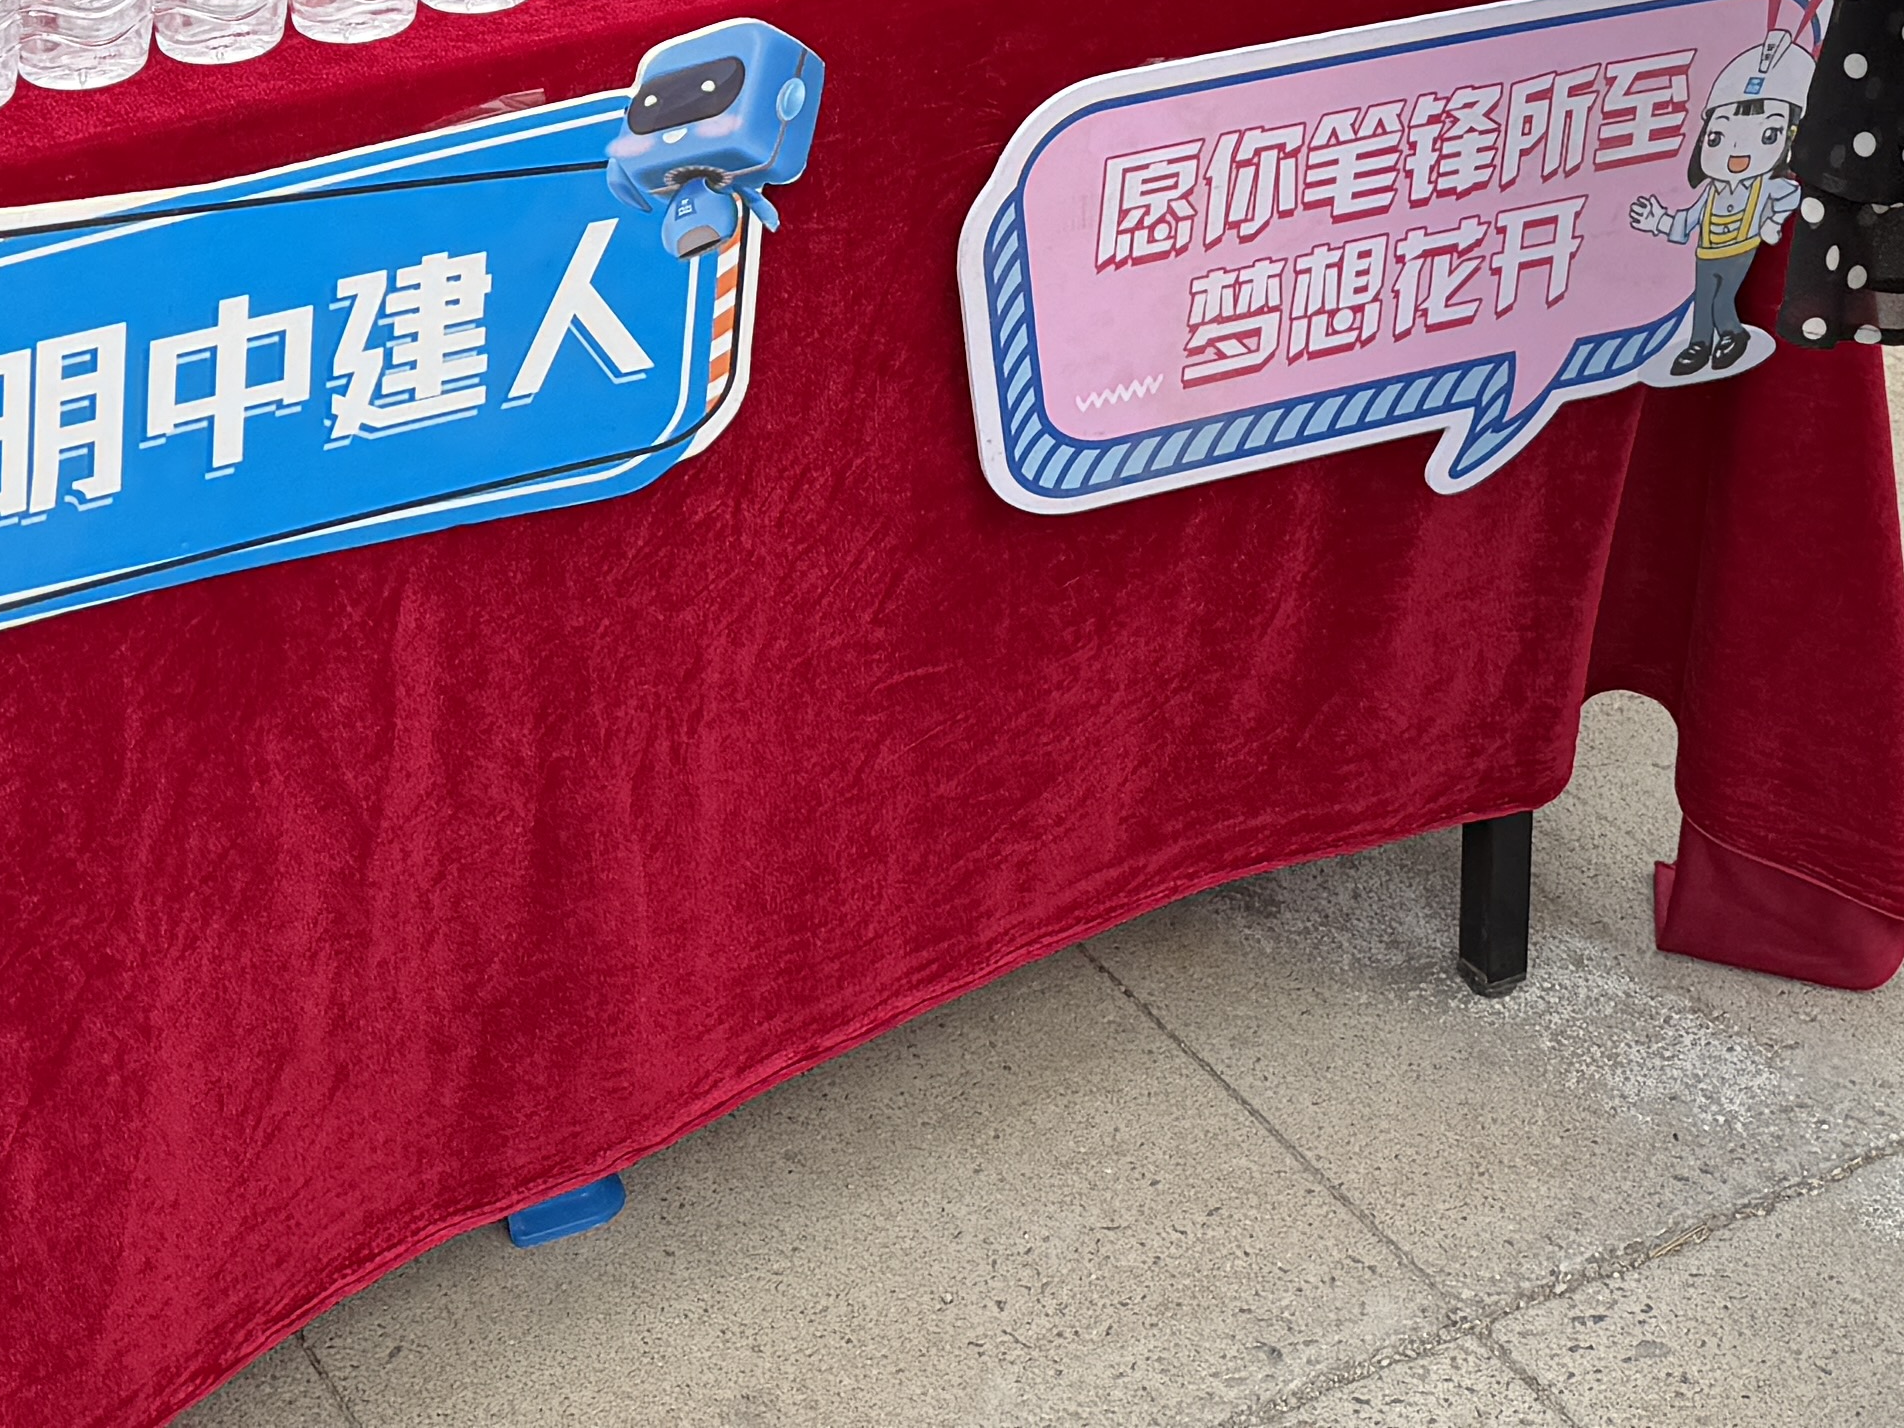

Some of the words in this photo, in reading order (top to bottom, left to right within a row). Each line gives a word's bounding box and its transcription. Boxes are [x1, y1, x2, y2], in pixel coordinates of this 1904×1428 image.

[1095, 48, 1698, 275] 愿你笔锋所至
[1181, 195, 1590, 390] 梦想花开
